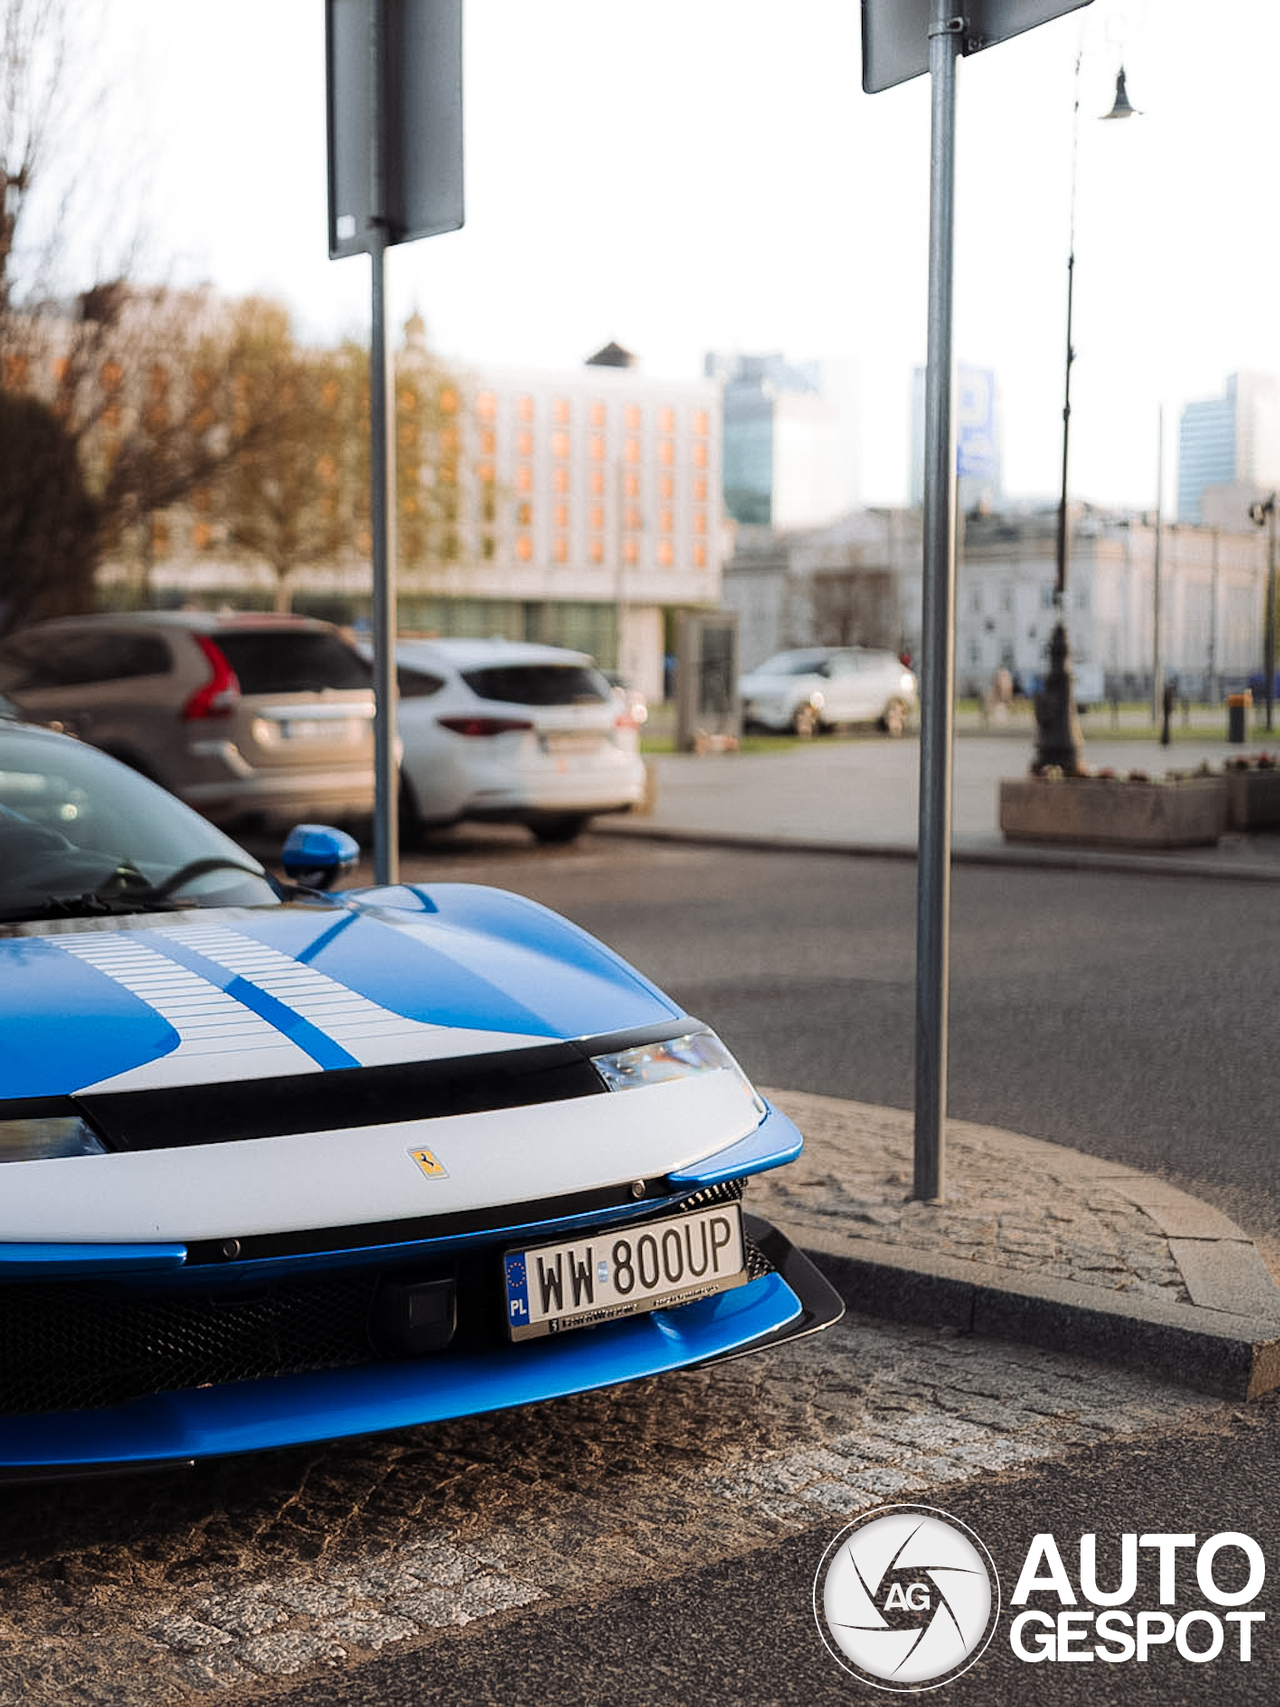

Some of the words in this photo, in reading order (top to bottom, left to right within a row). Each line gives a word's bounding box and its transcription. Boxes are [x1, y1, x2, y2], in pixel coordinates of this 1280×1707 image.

[536, 1247, 594, 1313] WW
[612, 1217, 732, 1295] 800UP
[510, 1299, 527, 1317] PL
